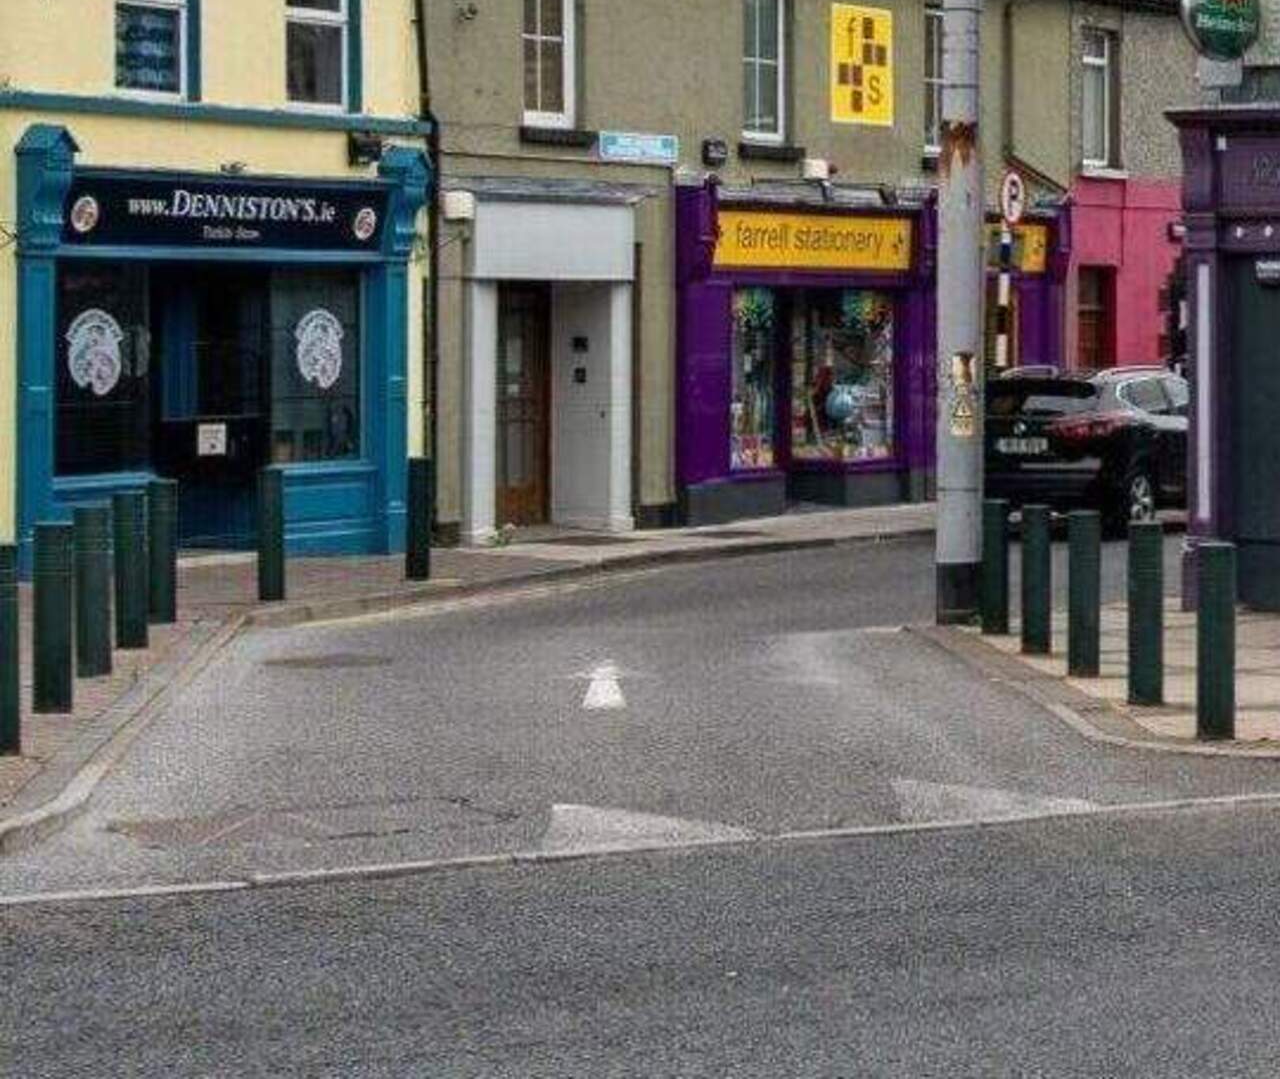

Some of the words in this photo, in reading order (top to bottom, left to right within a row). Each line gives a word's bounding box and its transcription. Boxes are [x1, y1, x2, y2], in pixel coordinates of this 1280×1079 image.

[1008, 180, 1020, 217] P
[736, 220, 788, 249] farrell
[793, 225, 884, 259] stationery
